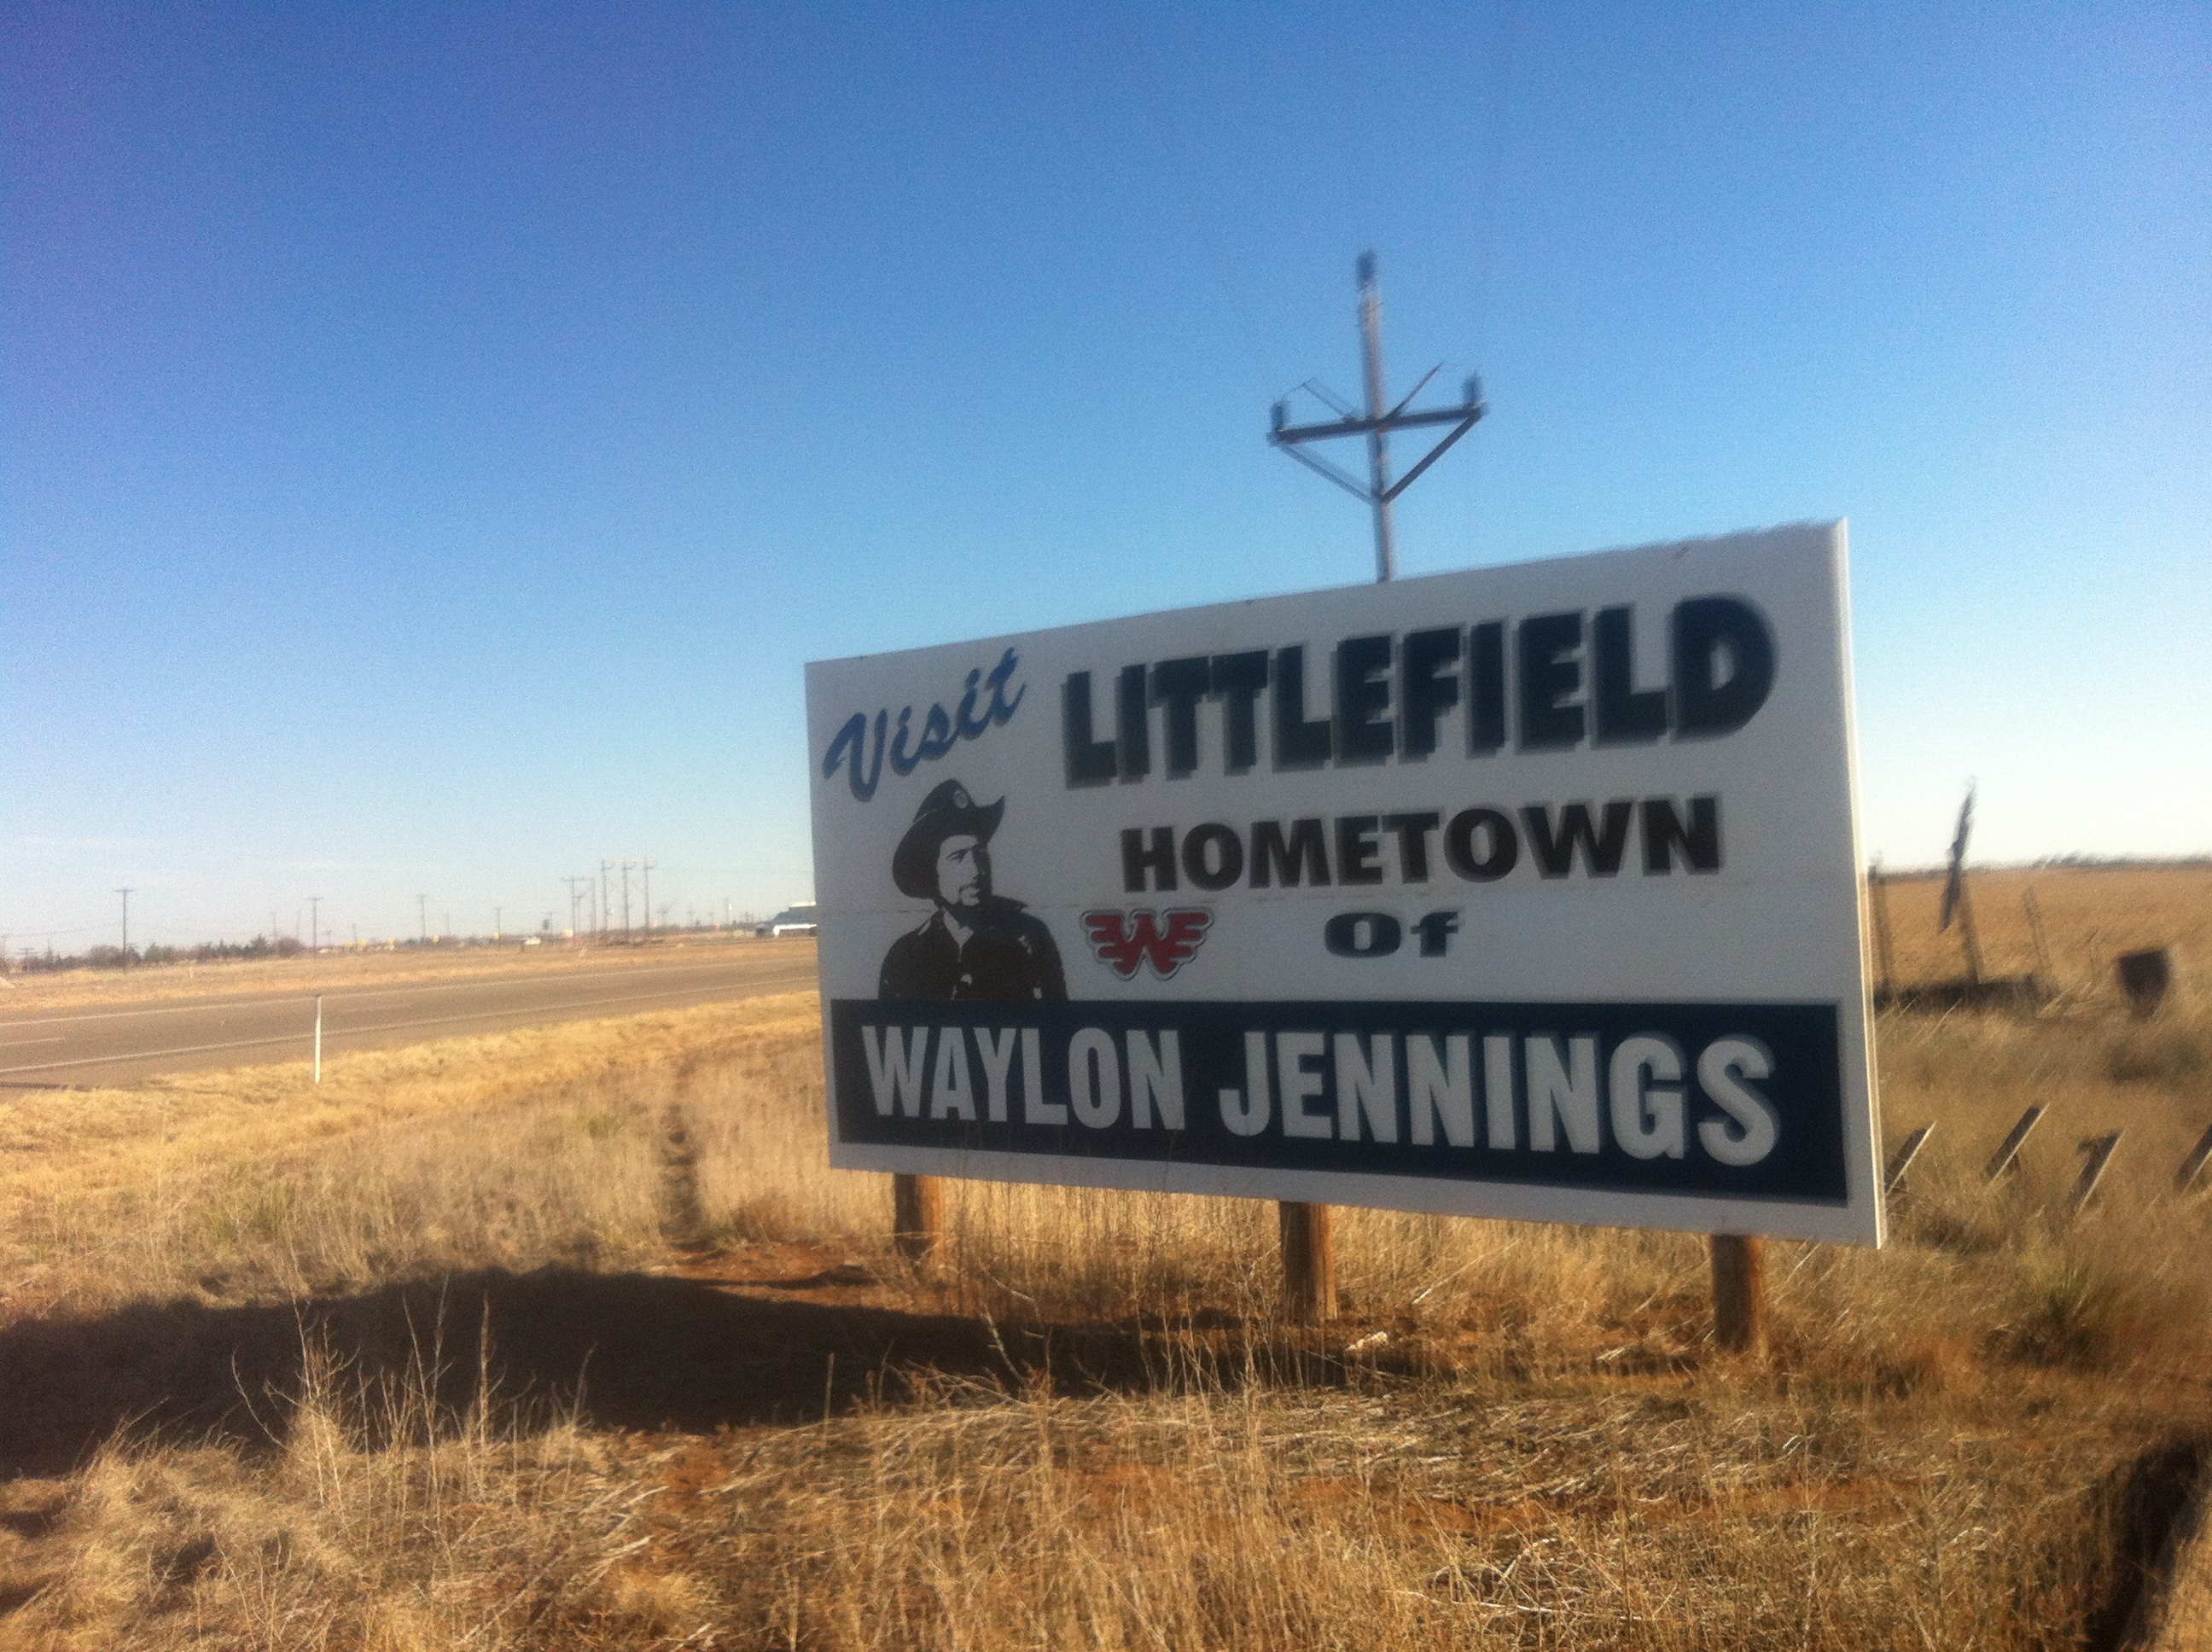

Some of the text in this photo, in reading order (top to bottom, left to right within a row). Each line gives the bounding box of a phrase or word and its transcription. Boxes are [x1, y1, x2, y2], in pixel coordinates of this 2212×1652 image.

[822, 594, 1778, 802] Visit LITTLEFIELD
[1121, 794, 1722, 893] HOMETOWN
[1324, 909, 1464, 959] Of
[862, 1025, 1778, 1166] WAYLON JENNINGS
